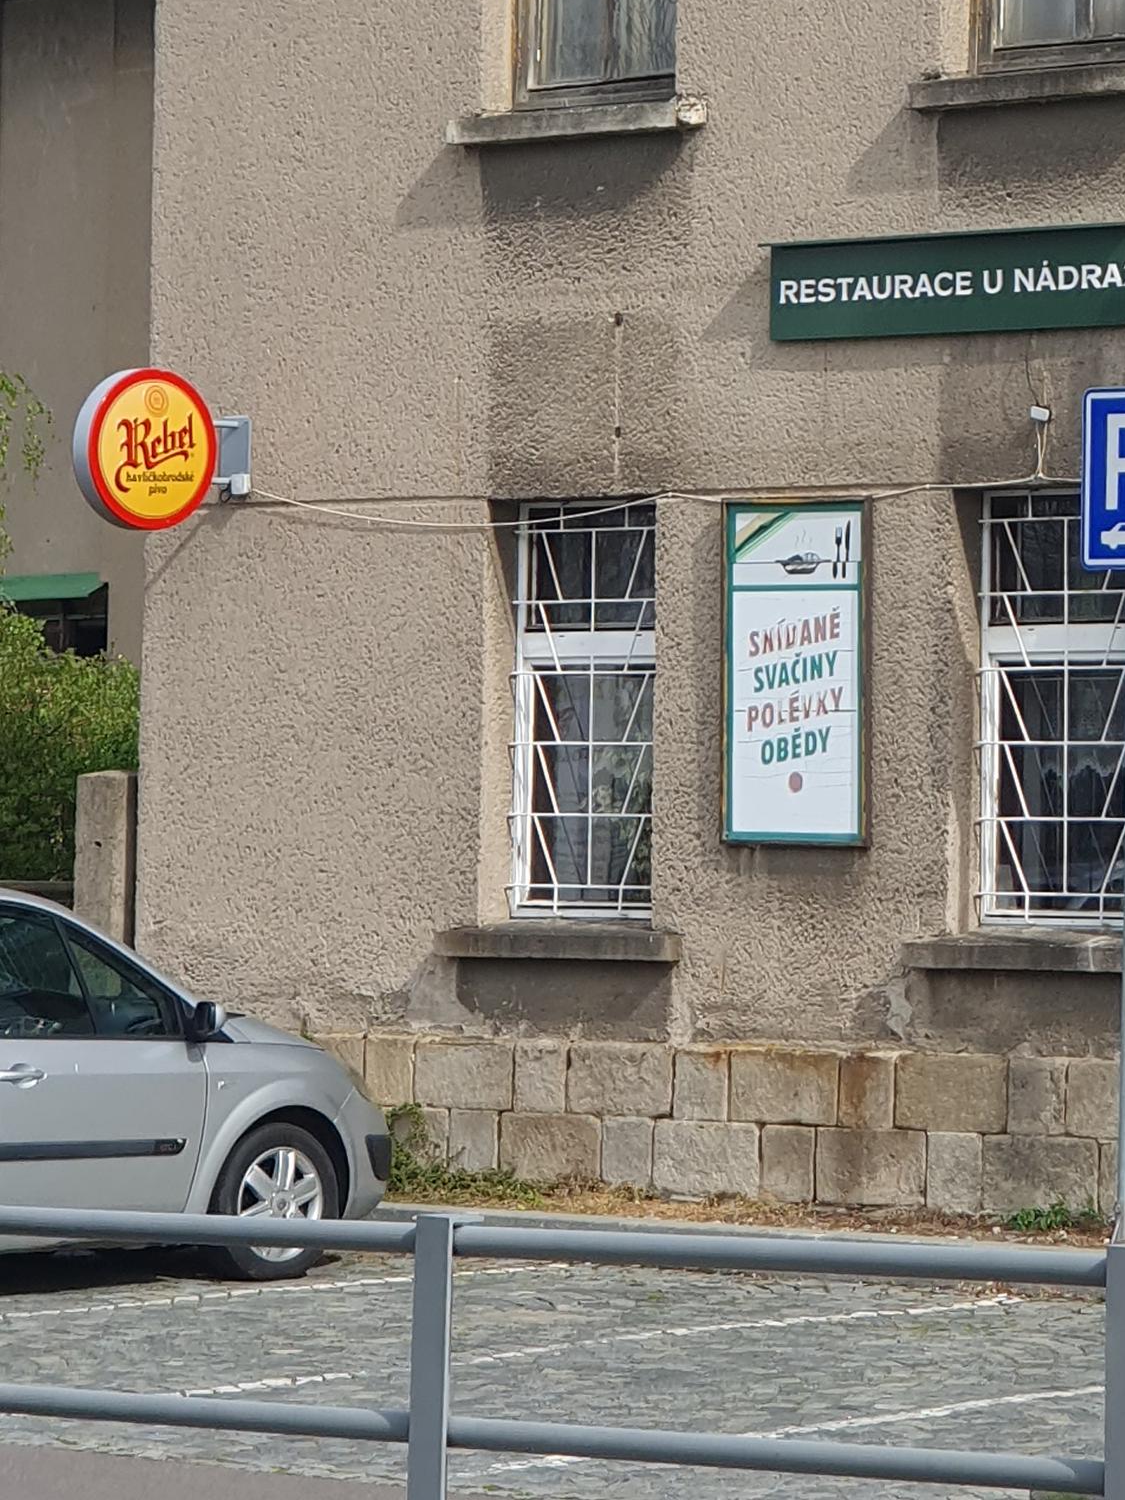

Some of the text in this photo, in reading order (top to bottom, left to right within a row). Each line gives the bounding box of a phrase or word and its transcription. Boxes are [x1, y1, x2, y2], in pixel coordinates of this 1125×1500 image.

[779, 271, 974, 305] RESTAURACE
[983, 268, 1004, 295] U
[116, 411, 196, 476] Rebel
[748, 605, 841, 658] SNÍDANĚ
[753, 650, 838, 693] SVAČINY
[746, 686, 843, 733] POLÉVKY
[760, 726, 832, 765] OBĚDY
